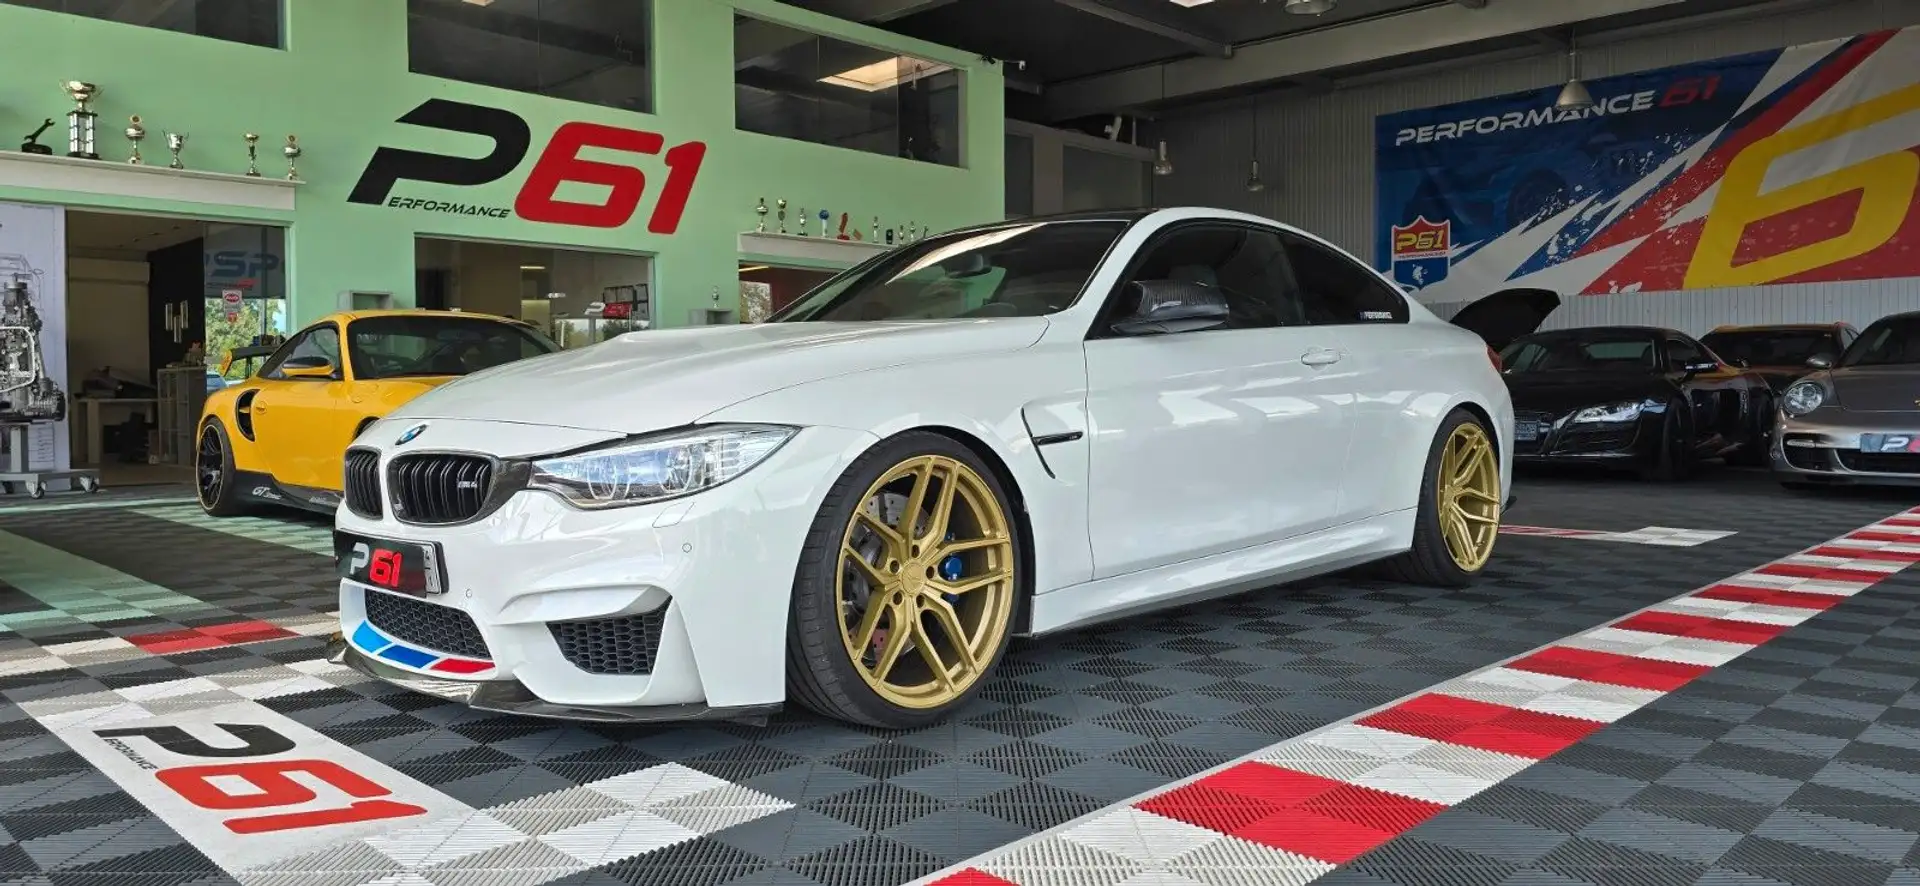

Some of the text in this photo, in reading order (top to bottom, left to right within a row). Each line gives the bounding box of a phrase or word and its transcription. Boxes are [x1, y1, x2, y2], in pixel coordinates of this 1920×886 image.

[1396, 75, 1720, 146] PERFORMANCE 61
[346, 98, 707, 235] P61
[388, 196, 511, 218] ERFORMANCE
[1396, 229, 1445, 251] P61
[350, 542, 403, 587] P61
[92, 723, 428, 834] P61
